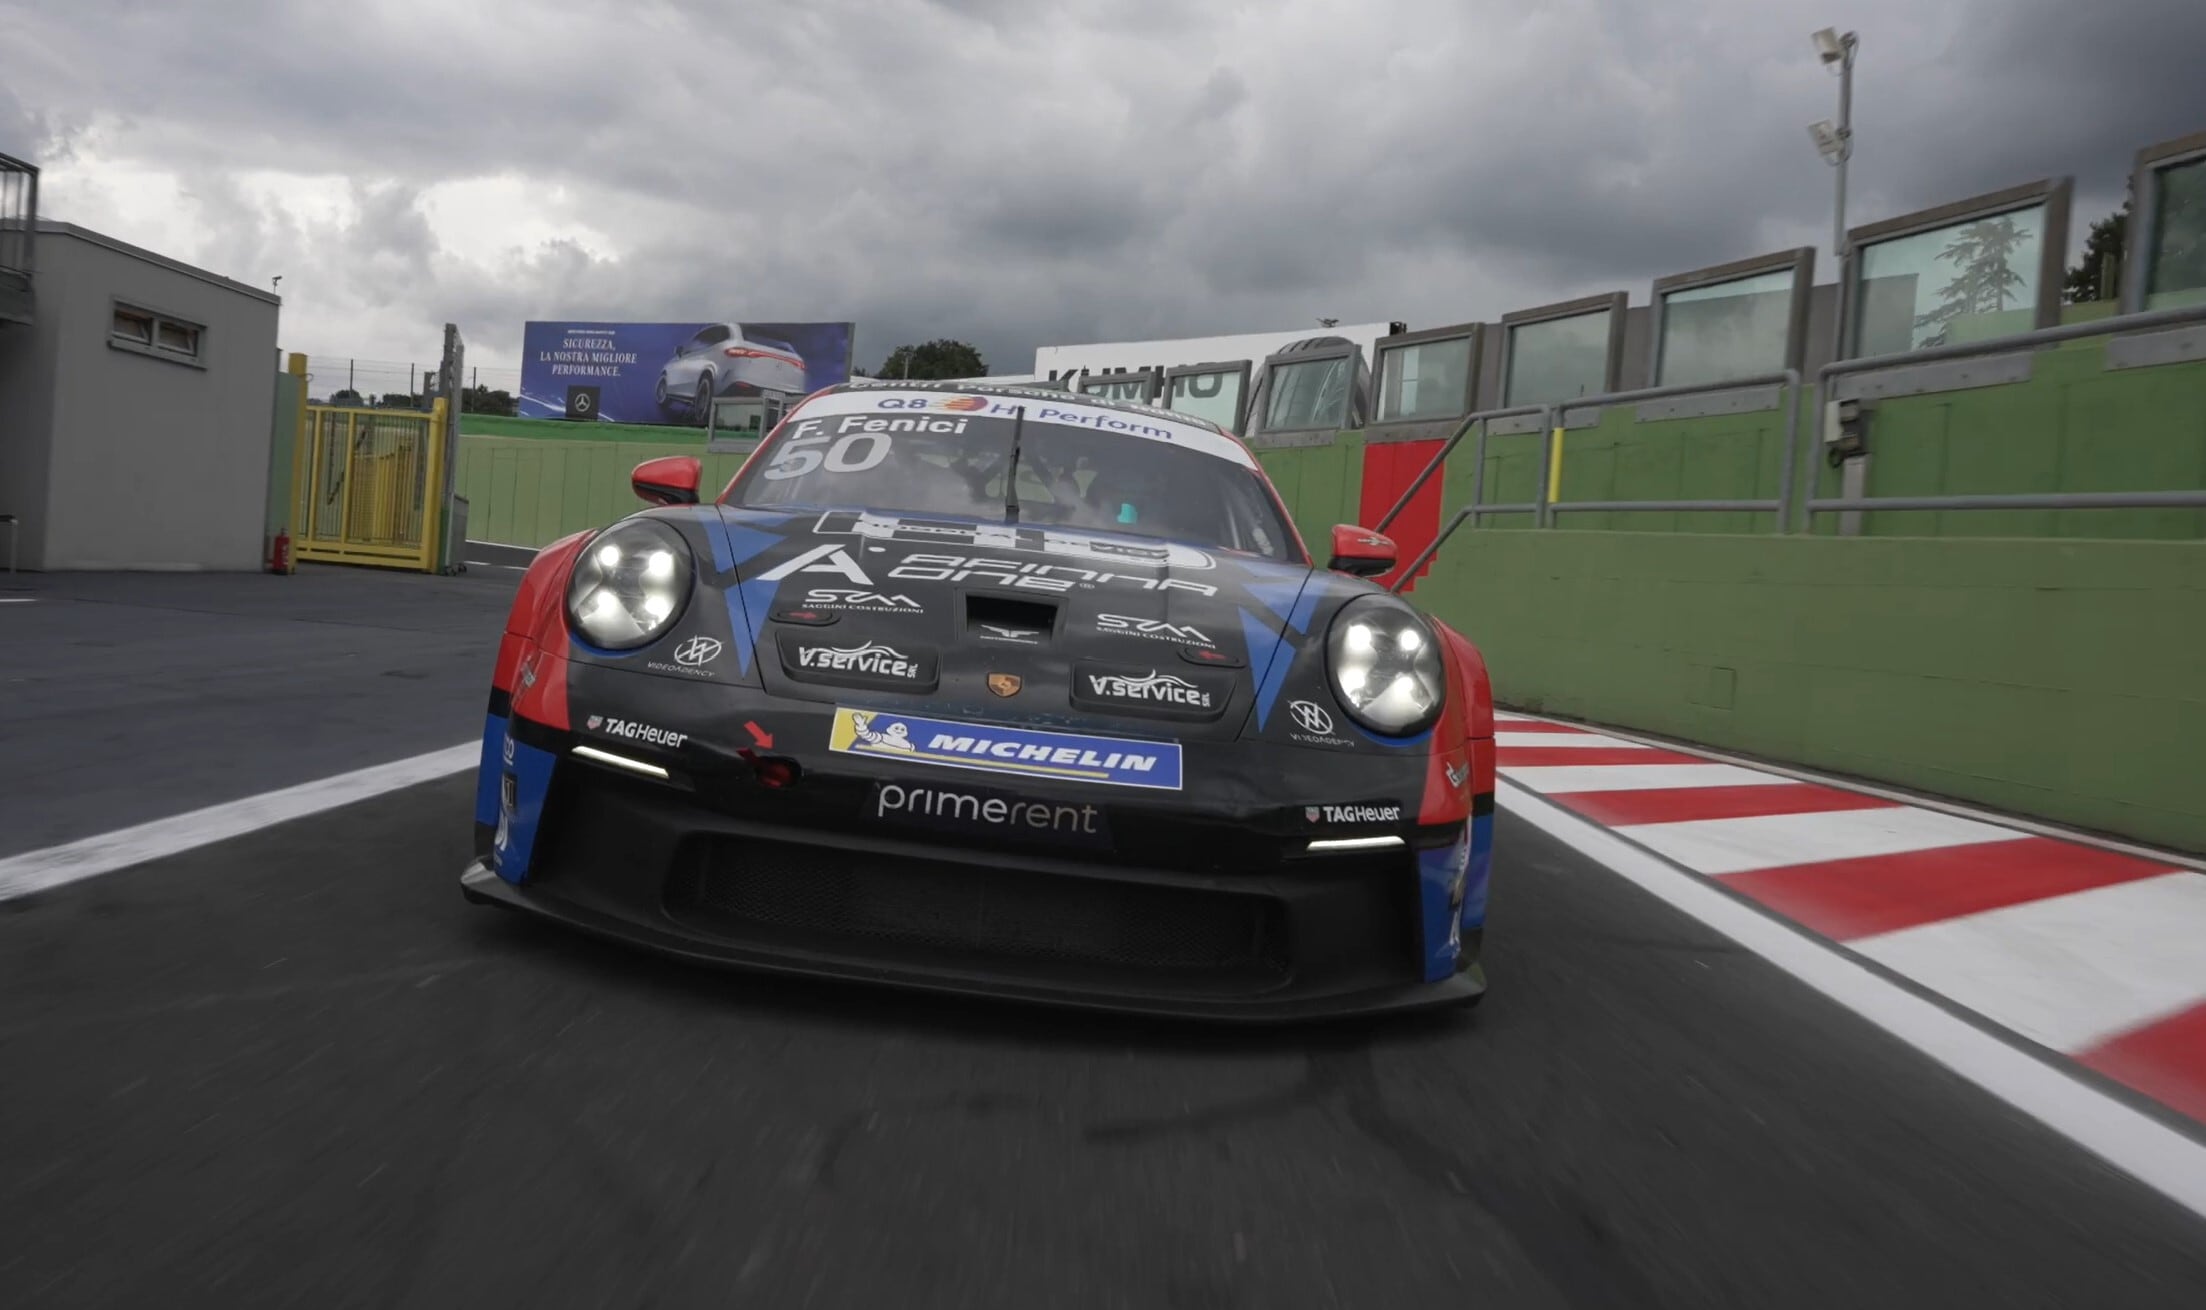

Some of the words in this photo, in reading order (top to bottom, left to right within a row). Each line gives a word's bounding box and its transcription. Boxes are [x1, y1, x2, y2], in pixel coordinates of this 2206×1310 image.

[540, 351, 551, 361] LA
[553, 351, 589, 362] NOSTRA
[592, 353, 638, 364] MIGLIORE
[563, 338, 616, 351] SICUREZZA,
[552, 364, 621, 376] PERFORMANCE.
[792, 419, 824, 439] F.
[837, 416, 969, 434] Fenici
[877, 398, 928, 410] Q8
[1039, 408, 1172, 439] Perform
[763, 432, 892, 480] 50
[849, 605, 924, 614] COSTRUZIONI
[799, 646, 907, 677] V.service
[1089, 675, 1200, 706] V.service
[928, 734, 1157, 771] MICHELIN
[878, 784, 1097, 834] primerent
